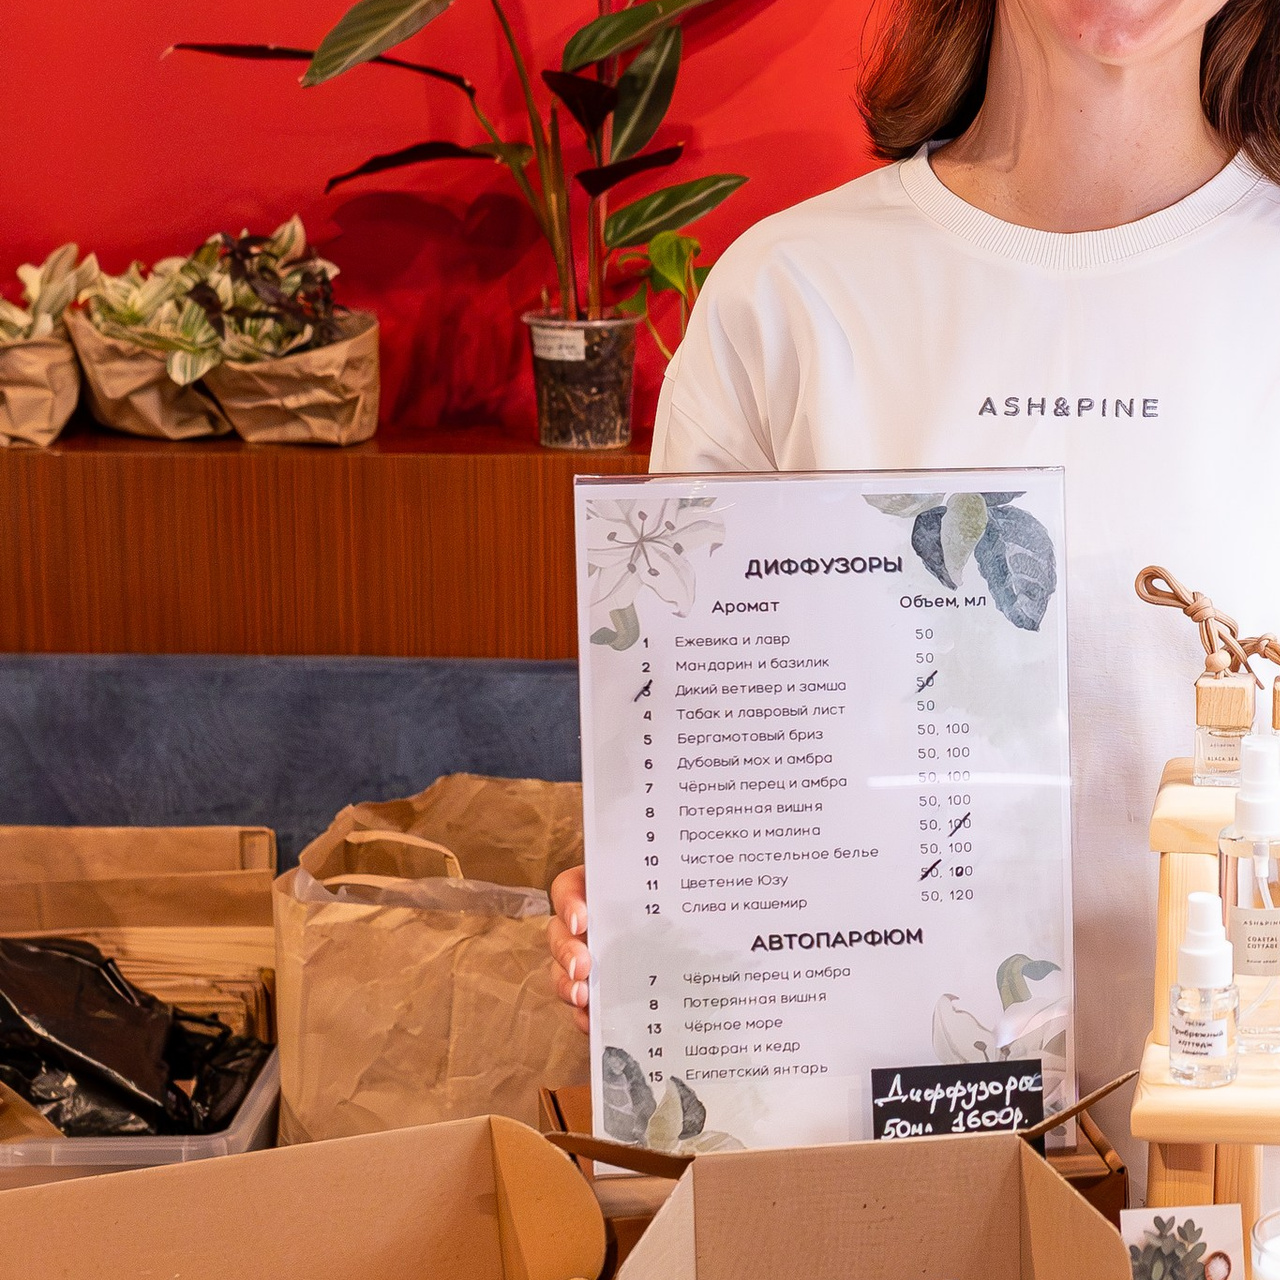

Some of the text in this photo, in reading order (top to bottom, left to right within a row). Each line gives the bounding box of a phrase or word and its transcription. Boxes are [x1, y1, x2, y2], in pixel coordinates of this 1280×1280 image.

[977, 395, 1160, 419] ASH&PINE
[744, 555, 904, 580] ДИФФУЗОРЫ
[711, 599, 781, 616] Аромат
[899, 595, 987, 609] Объем, мл
[642, 634, 791, 649] 1 Ежевика и лавр
[915, 627, 934, 640] 50
[641, 657, 830, 674] 2 Мандарин и базилик
[915, 652, 935, 664] 50
[674, 683, 721, 698] Дикий
[721, 683, 783, 696] ветивер
[786, 683, 796, 693] и
[798, 681, 847, 693] замша
[642, 704, 846, 722] 4 Табак и лавровый лист
[916, 699, 936, 712] 50
[643, 728, 824, 747] 5 Бергамотовый бриз
[917, 722, 970, 737] 50, 100
[644, 752, 833, 771] 6 Дубовый мох и амбра
[917, 746, 971, 760] 50, 100
[644, 775, 848, 795] 7 Чёрный перец и амбра
[918, 793, 972, 808] 50, 100
[644, 802, 823, 819] 8 Потерянная вишня
[919, 818, 942, 832] 50,
[645, 826, 821, 844] 9 Просекко и малина
[643, 847, 879, 867] 10 Чистое постельное белье
[919, 841, 973, 856] 50, 100
[646, 874, 789, 891] 11 Цветение Юзу
[920, 888, 974, 903] 50, 120
[644, 898, 808, 915] 12 Слива и кашемир
[750, 927, 924, 953] АВТОПАРФЮМ
[648, 965, 851, 987] 7 Чёрный перец и амбра
[648, 992, 827, 1011] 8 Потерянная вишня
[646, 1018, 784, 1035] 13 Чёрное море
[647, 1041, 801, 1059] 14 Шафран и кедр
[648, 1063, 829, 1083] 15 Египетский янтарь
